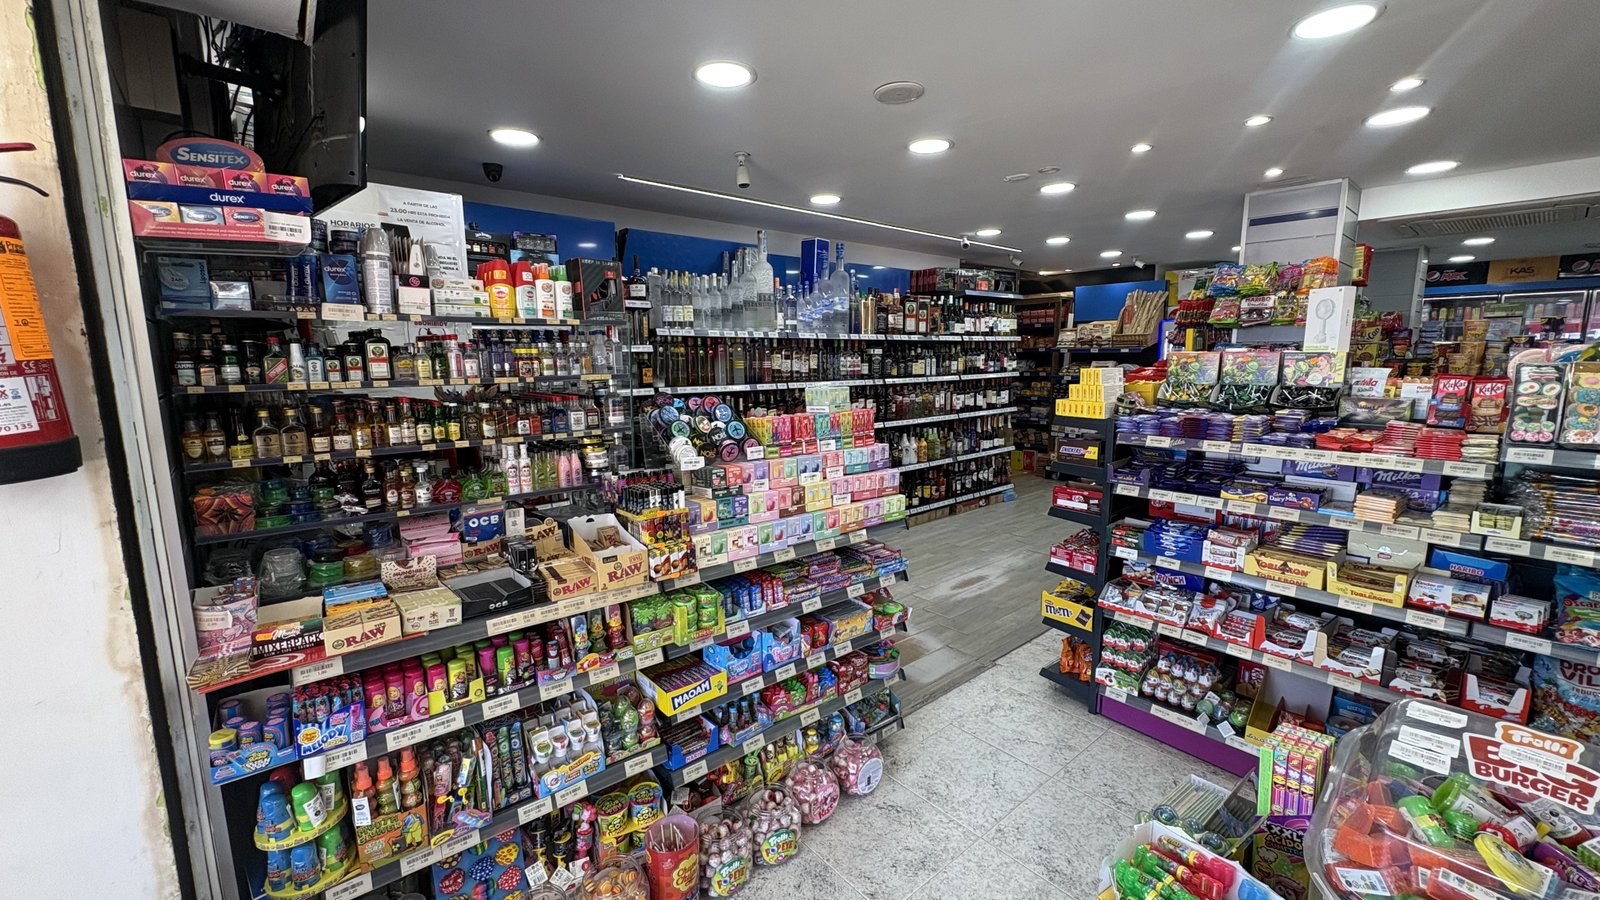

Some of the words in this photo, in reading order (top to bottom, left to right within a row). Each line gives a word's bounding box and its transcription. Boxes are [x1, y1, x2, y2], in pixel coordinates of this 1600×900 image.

[177, 146, 247, 165] SENSITEX
[129, 170, 157, 179] durex
[180, 175, 206, 183] durex
[228, 179, 252, 187] durex
[271, 183, 294, 191] durex
[209, 193, 245, 204] durex
[323, 265, 346, 273] durex
[1510, 266, 1535, 275] KAS
[1442, 380, 1468, 391] KitKat
[1478, 383, 1504, 395] KitKat
[15, 422, 33, 431] 135
[1373, 470, 1422, 482] Milka
[469, 514, 499, 528] OCB
[474, 542, 500, 557] RAW
[607, 561, 643, 583] RAW
[1450, 564, 1484, 576] HARIBO
[561, 576, 592, 595] RAW
[1350, 590, 1393, 603] TOBLERONE
[489, 600, 509, 609] OCB
[345, 626, 386, 648] RAW
[673, 678, 711, 706] MAOAM
[301, 725, 346, 756] MELODY
[1508, 729, 1569, 755] Trolli
[1474, 761, 1590, 811] BURGER
[1270, 824, 1301, 842] XXL
[769, 833, 789, 847] Trolli
[720, 861, 741, 877] Trolli
